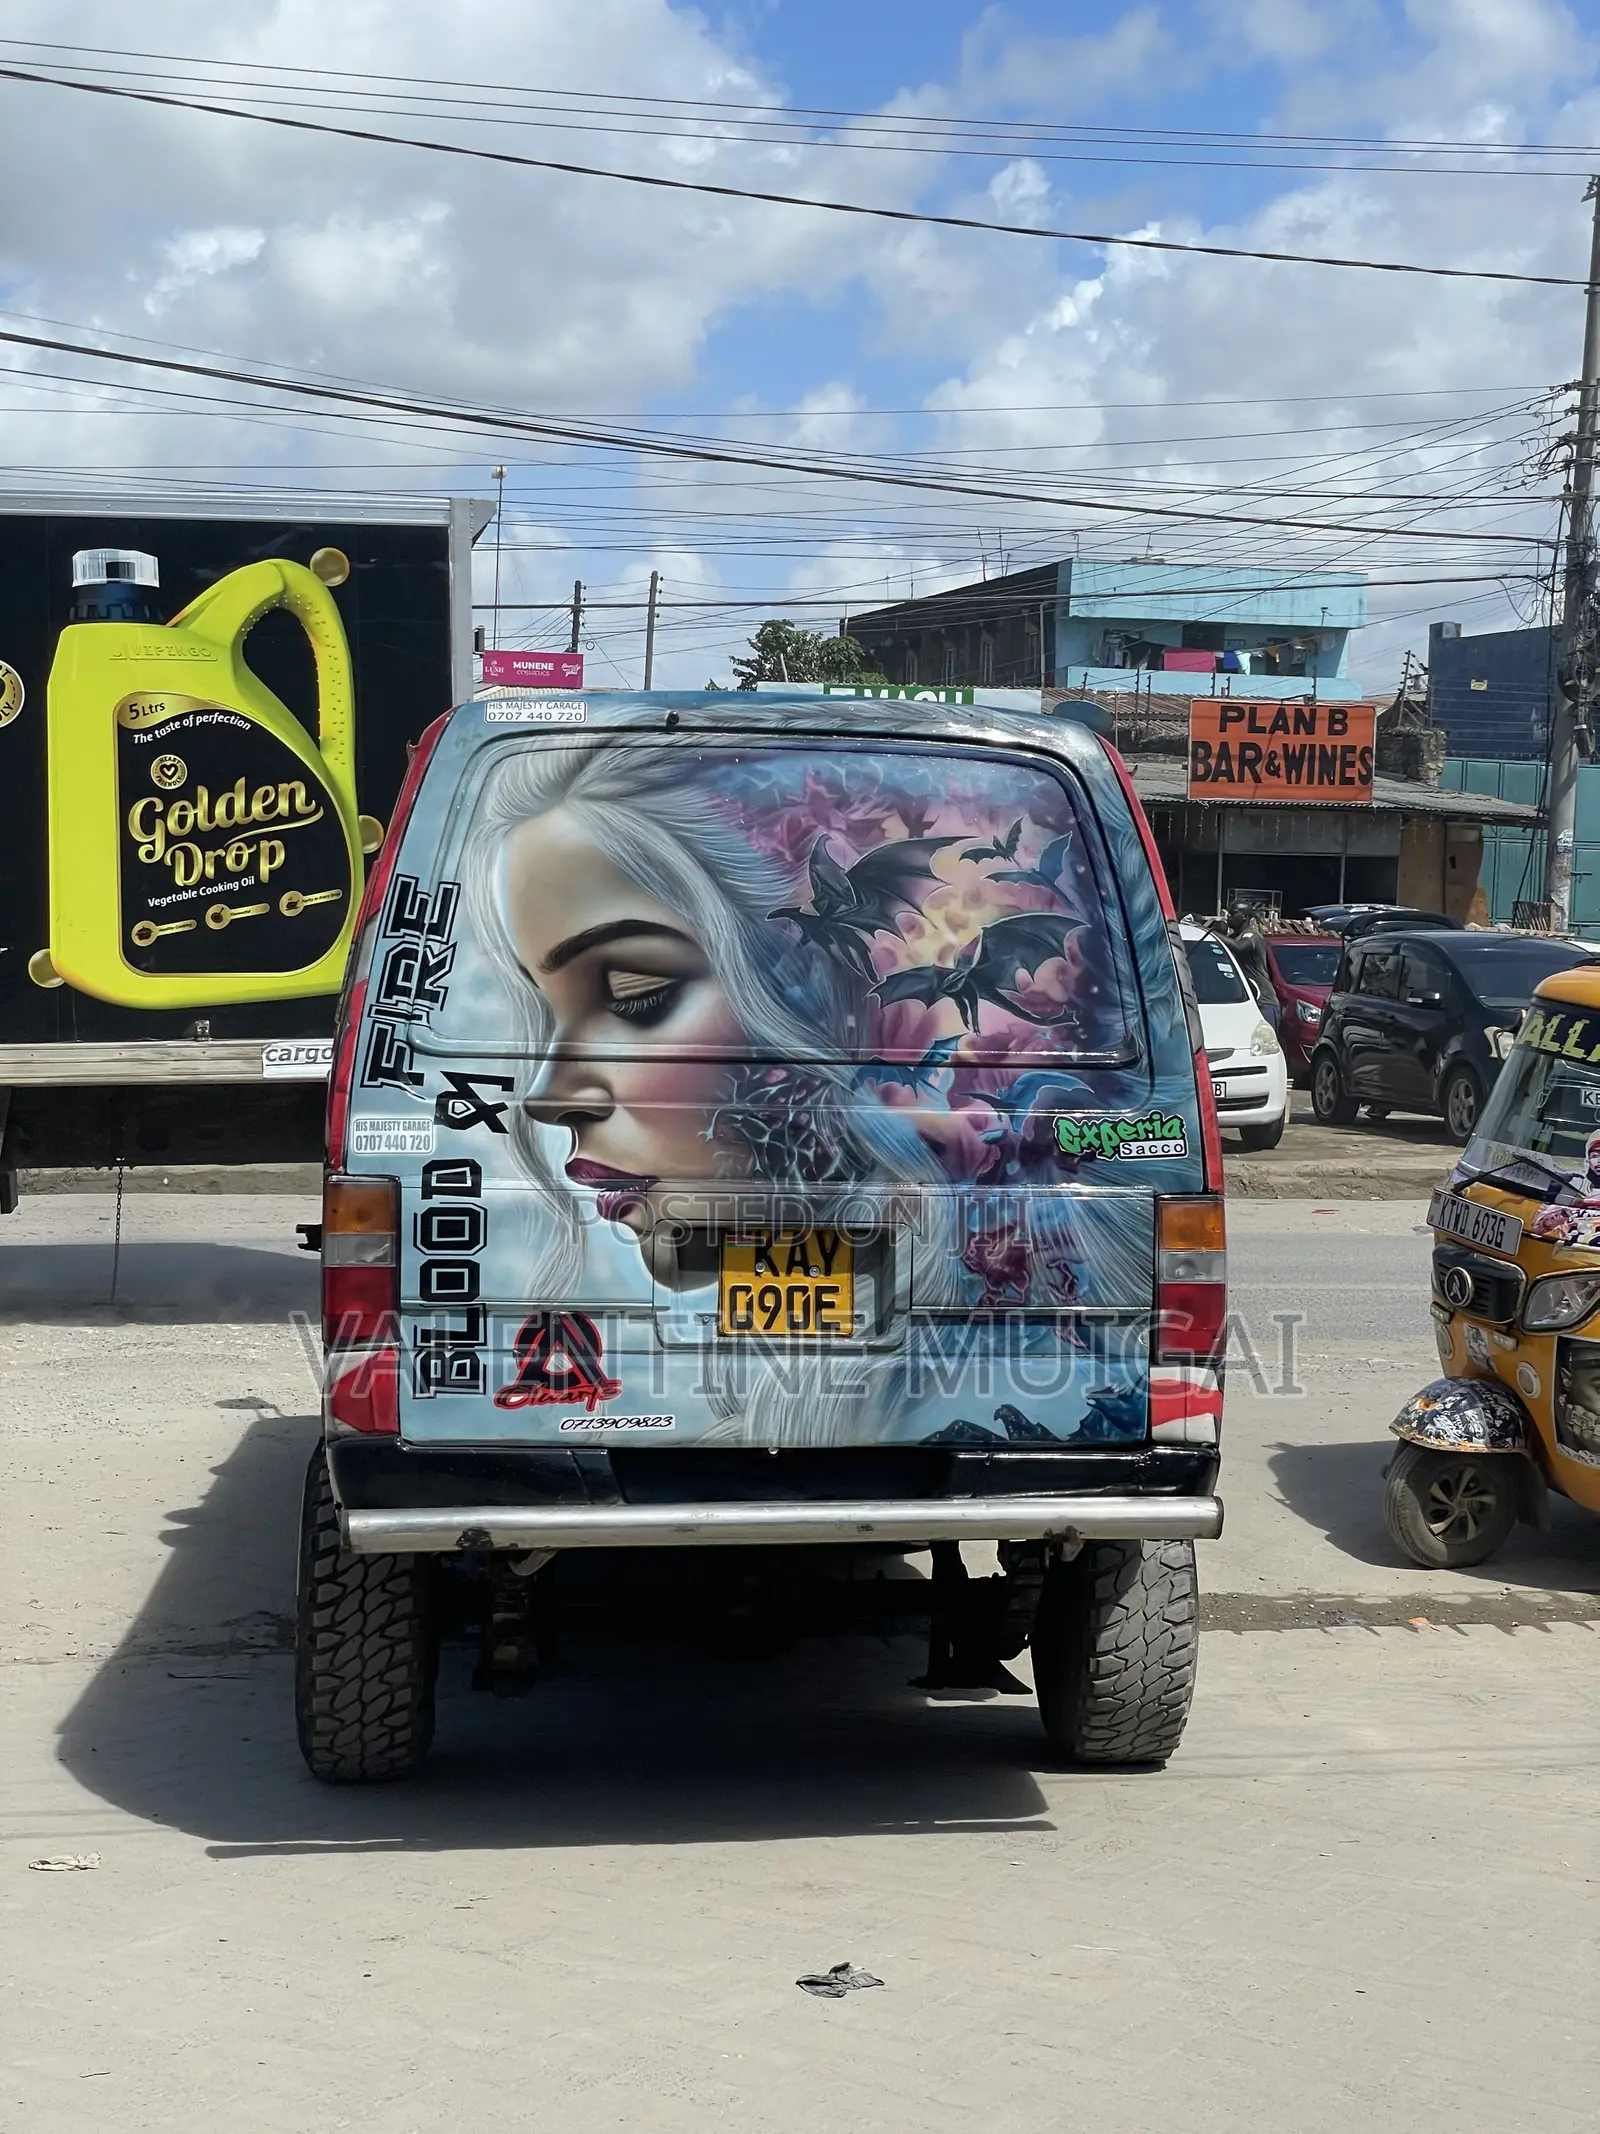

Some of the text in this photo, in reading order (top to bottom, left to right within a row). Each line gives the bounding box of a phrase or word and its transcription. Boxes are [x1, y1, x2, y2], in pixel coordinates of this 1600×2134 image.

[513, 661, 554, 671] MUNENE
[129, 702, 166, 720] 5 Ltrs
[488, 712, 583, 721] 0707 440 720
[489, 702, 583, 711] HIS MAJESTY GARAGE
[1219, 705, 1349, 736] PLAN B
[133, 712, 252, 744] The taste of perfection
[128, 776, 316, 864] Golden
[164, 839, 286, 887] Drop
[148, 875, 255, 908] Vegetable Cooking Oil
[360, 873, 461, 1089] FIRE
[355, 1121, 431, 1132] HIS MAJESTY GARAGE
[1057, 1113, 1184, 1157] Experia
[355, 1135, 431, 1151] 0707 440 720
[1121, 1143, 1184, 1156] Sacco
[1438, 1197, 1506, 1249] KTWD 693G
[754, 1230, 840, 1278] KAY
[413, 1158, 487, 1400] BLOOD
[729, 1284, 841, 1331] 090E
[560, 1416, 674, 1431] 0713909823
